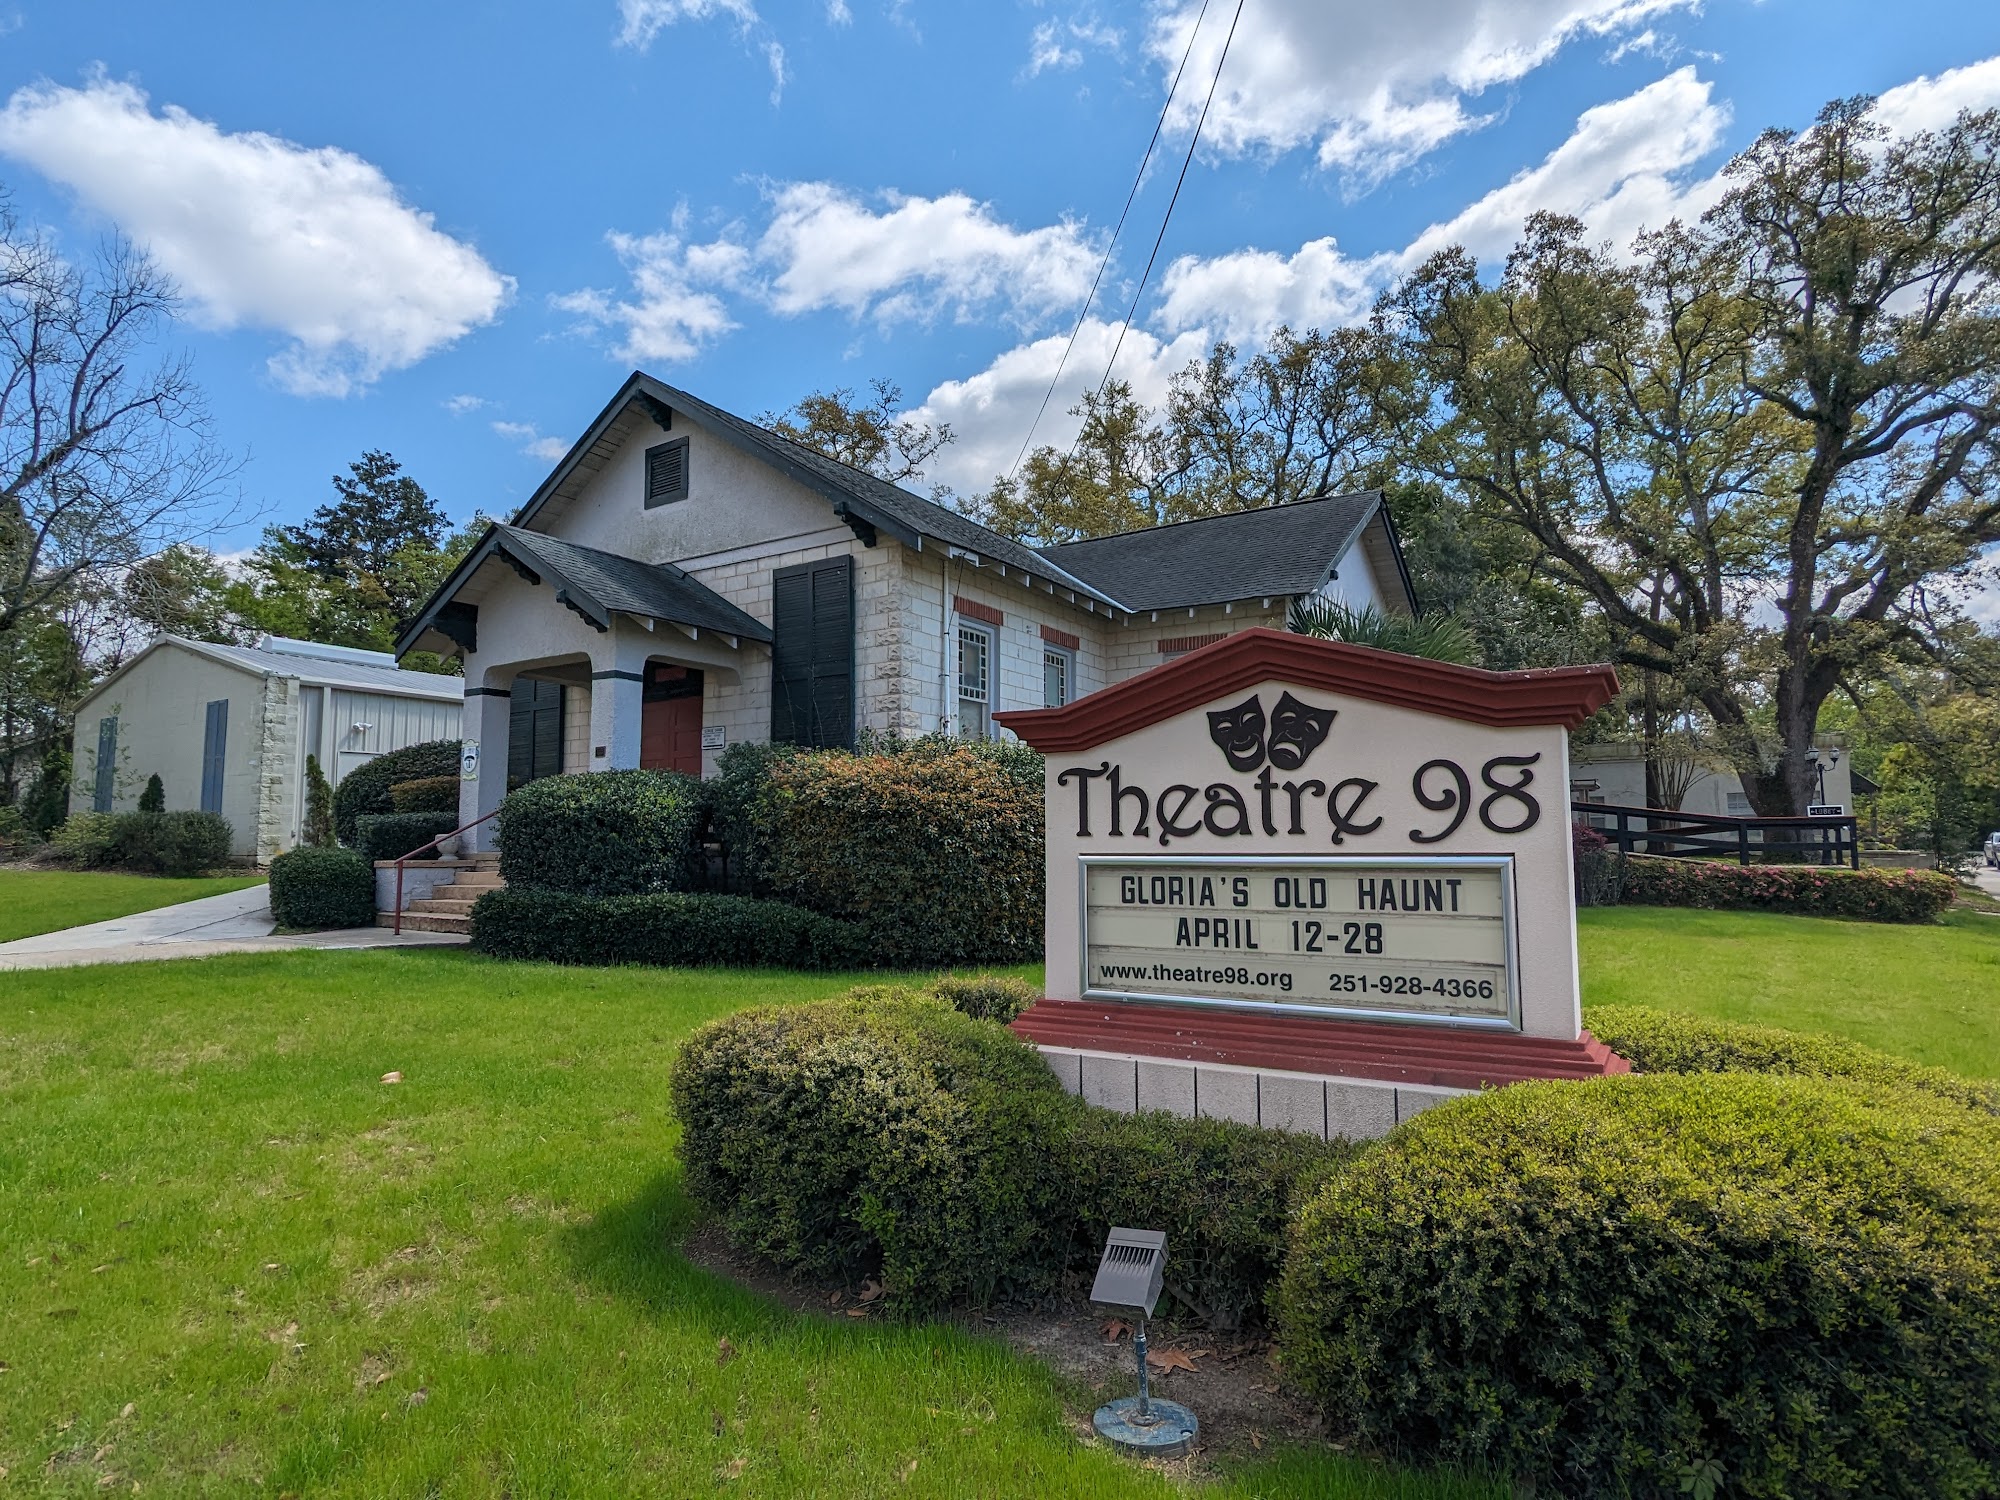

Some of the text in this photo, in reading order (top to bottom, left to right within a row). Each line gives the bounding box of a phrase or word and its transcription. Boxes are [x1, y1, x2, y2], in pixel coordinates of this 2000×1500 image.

[1057, 752, 1541, 846] Theatre 98
[1121, 875, 1462, 912] GLORIA'S OLD HAUNT
[1176, 916, 1383, 955] APRIL 12-28
[1100, 963, 1293, 991] www.theatre98.org
[1329, 973, 1494, 999] 251-928-4366
